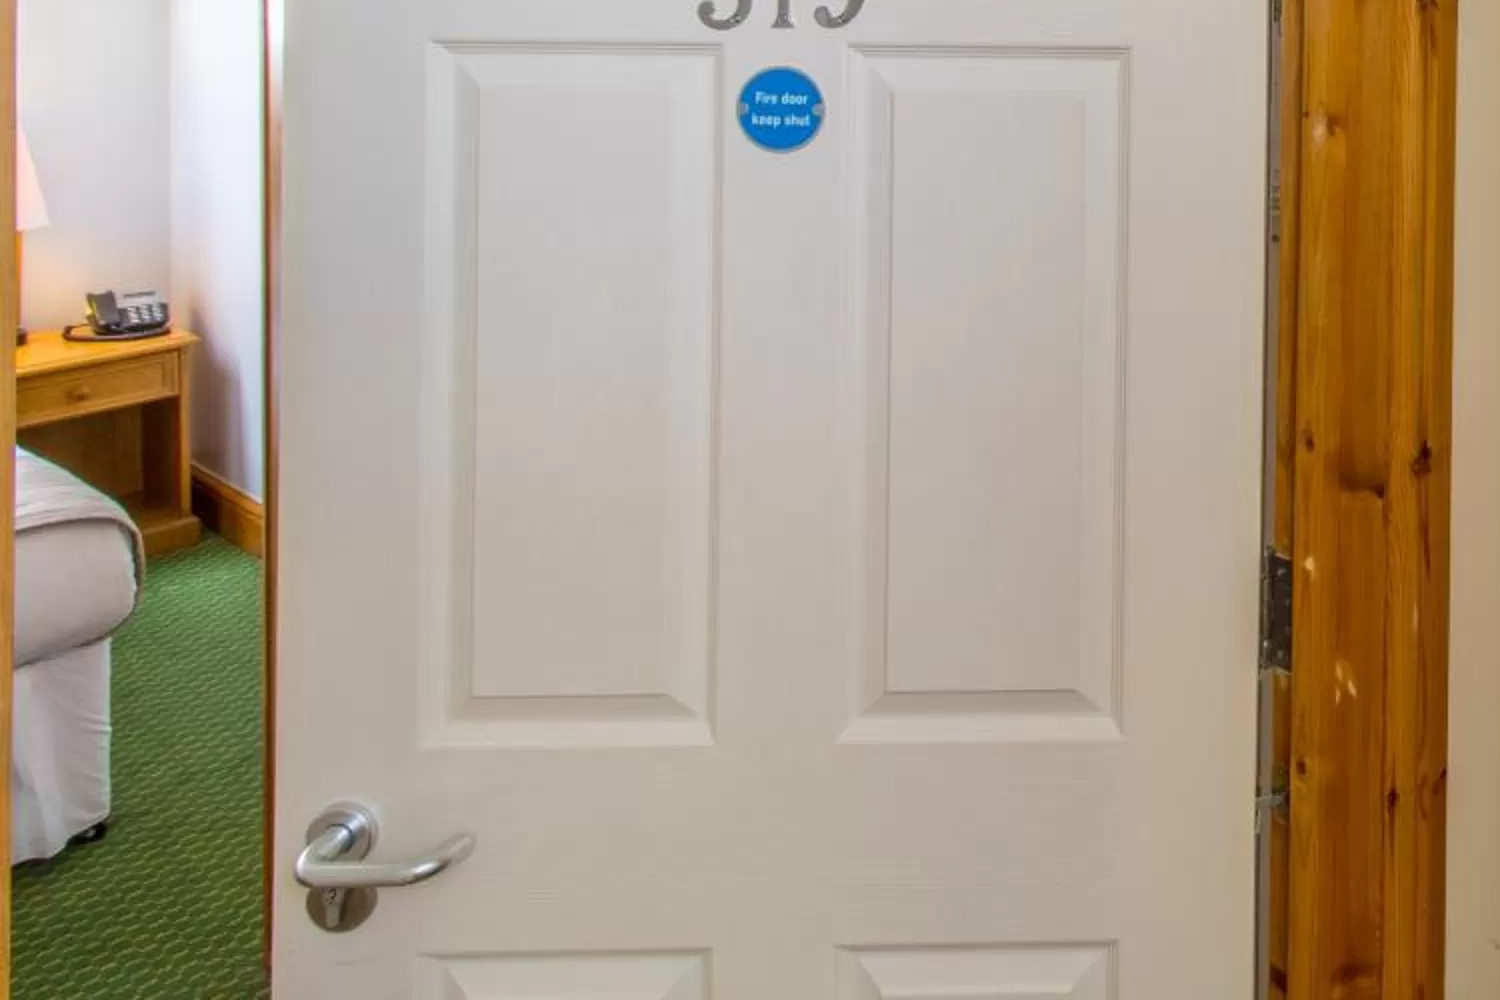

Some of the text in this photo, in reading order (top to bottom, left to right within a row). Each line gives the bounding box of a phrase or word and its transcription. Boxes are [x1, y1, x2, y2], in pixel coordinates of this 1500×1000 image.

[755, 91, 808, 105] Fire door
[751, 112, 810, 129] keep shut
